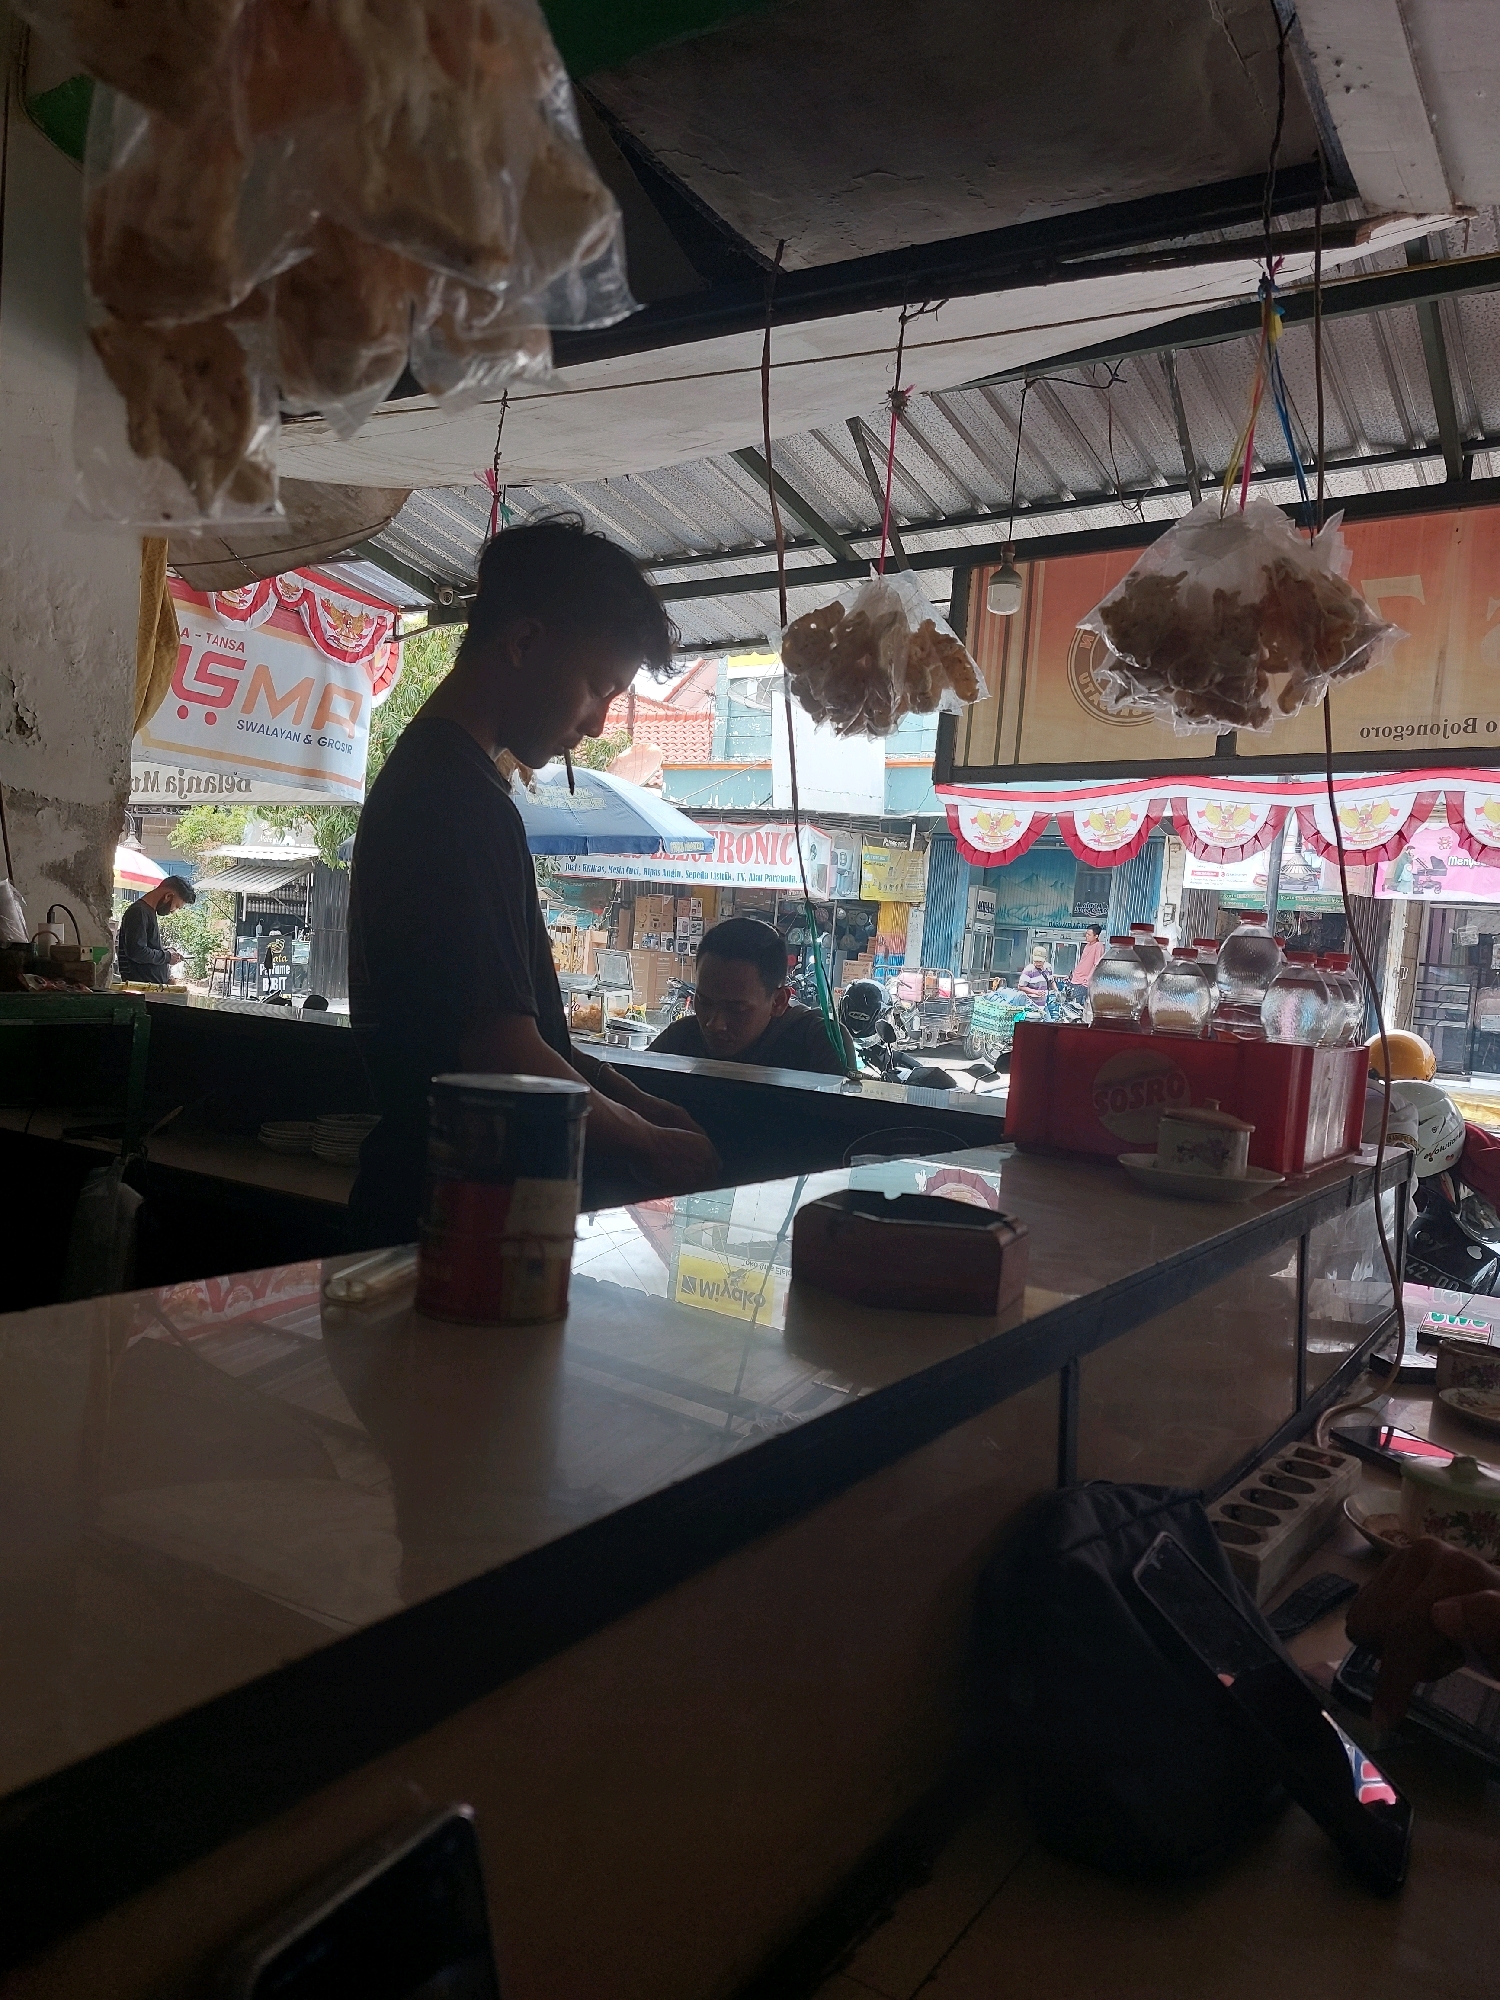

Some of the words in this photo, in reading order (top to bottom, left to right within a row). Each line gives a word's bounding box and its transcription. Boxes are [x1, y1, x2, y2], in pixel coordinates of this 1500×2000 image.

[206, 632, 245, 653] TANSA
[236, 719, 301, 743] SWALAYAN
[303, 734, 313, 745] &
[317, 736, 353, 755] GROSIR
[1093, 1073, 1186, 1118] SOSRO
